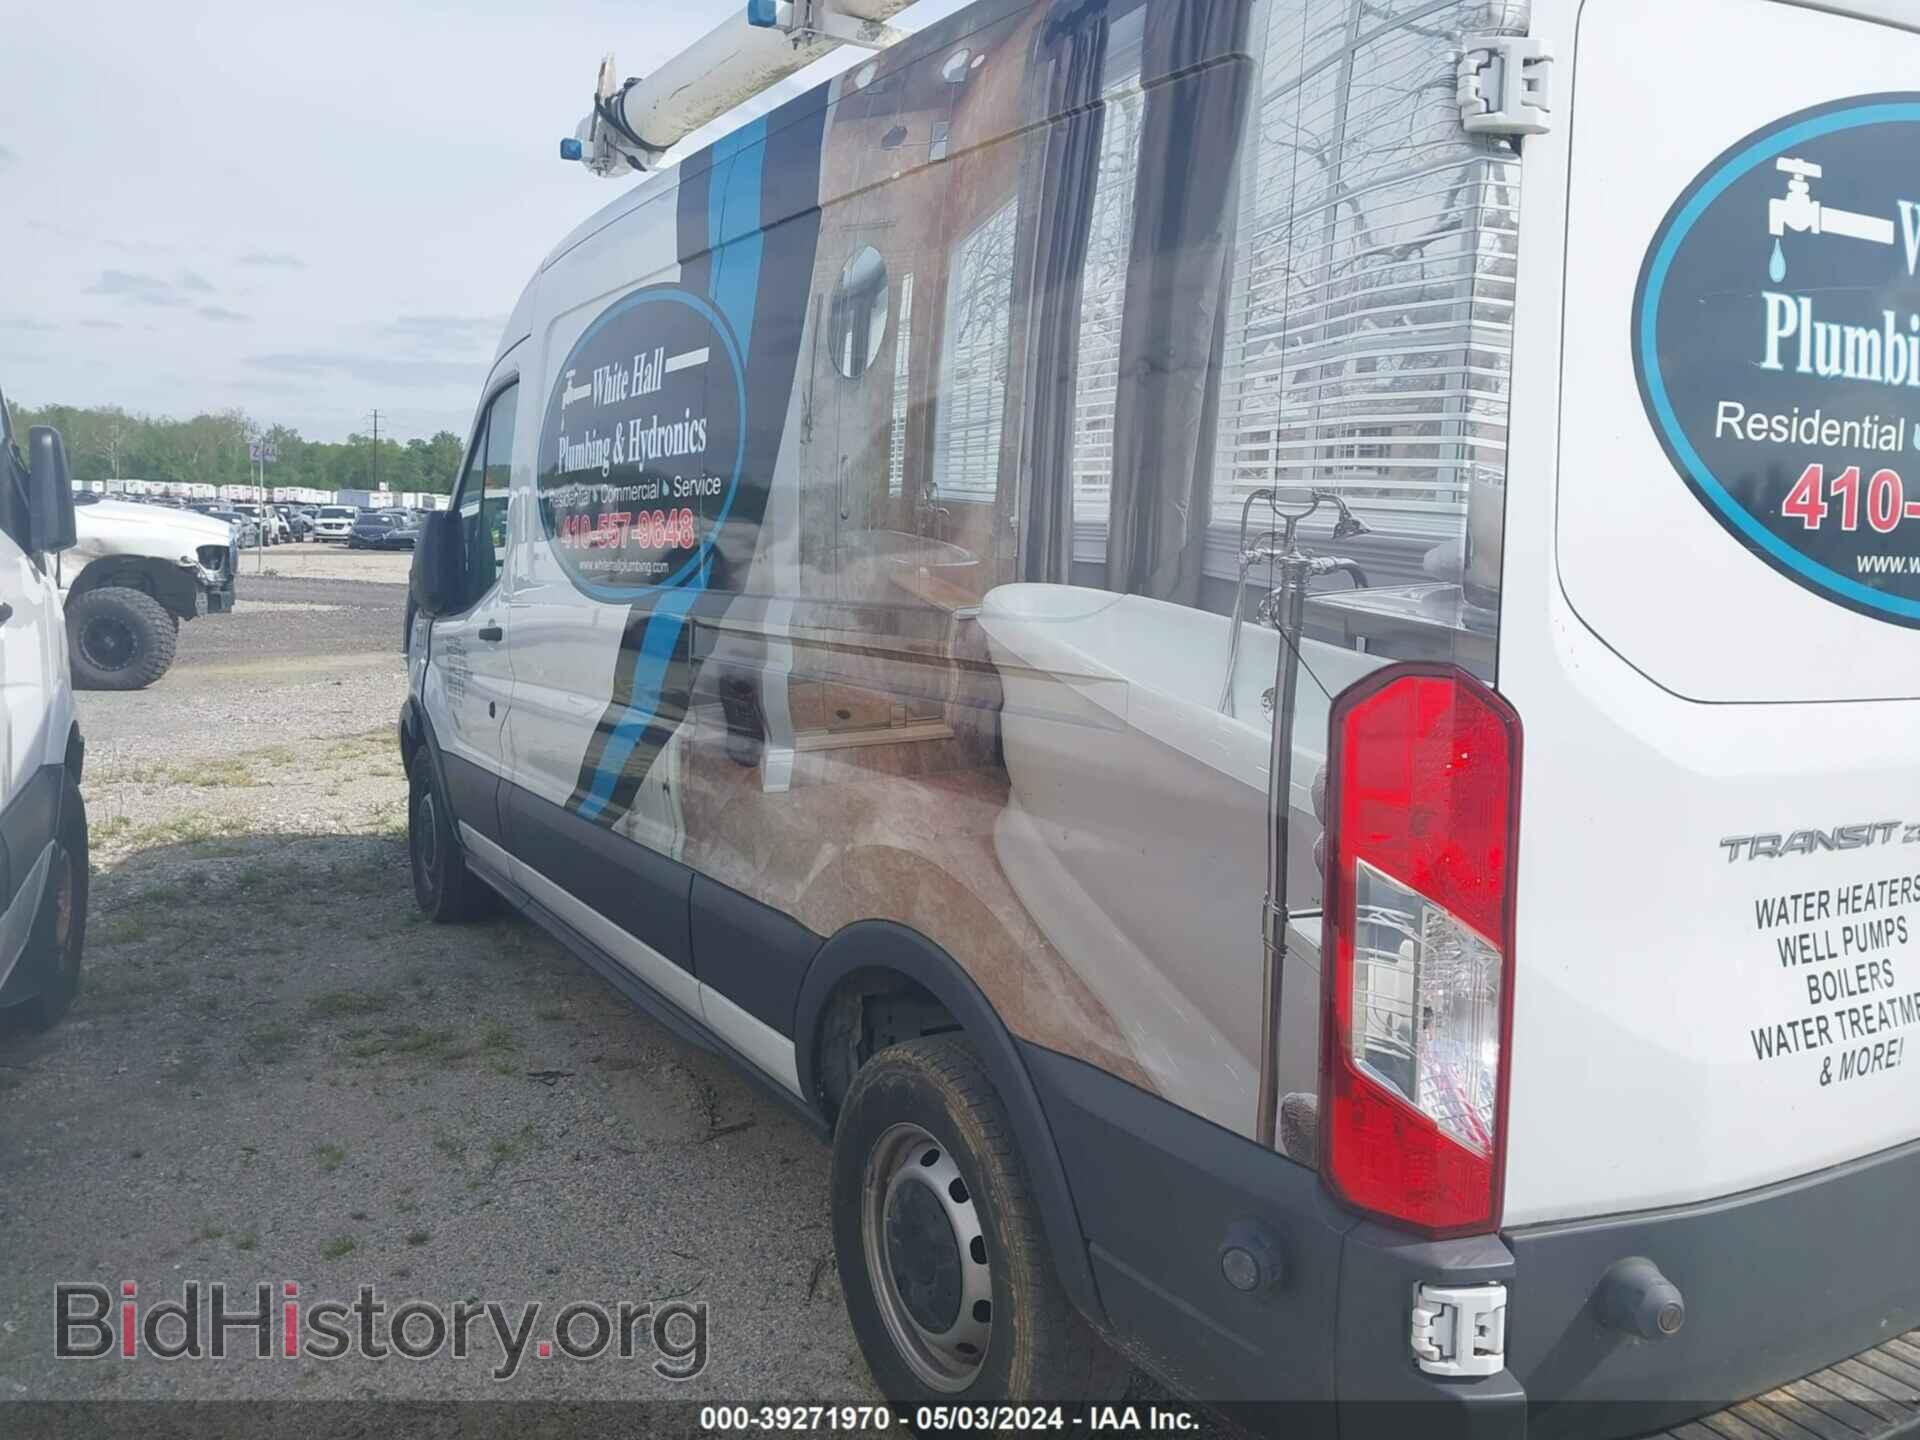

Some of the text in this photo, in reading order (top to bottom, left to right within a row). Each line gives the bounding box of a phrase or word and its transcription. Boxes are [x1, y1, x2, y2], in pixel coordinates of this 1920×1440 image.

[1760, 291, 1920, 387] Plumbi
[592, 347, 664, 409] White Hall
[557, 407, 708, 478] Plumbing & Hydronics
[1715, 401, 1905, 452] Residential
[599, 477, 660, 504] Commercial
[673, 473, 722, 498] Service
[1782, 463, 1920, 533] 410-
[561, 507, 695, 550] 410-557-9648
[1719, 821, 1902, 863] TRANSIT
[1755, 874, 1920, 930] WATER HEATERS
[1777, 914, 1909, 968] WELL PUMPS
[1806, 957, 1895, 1005] BOILERS
[1751, 1015, 1833, 1061] WATER
[1819, 1036, 1905, 1087] & MORE!
